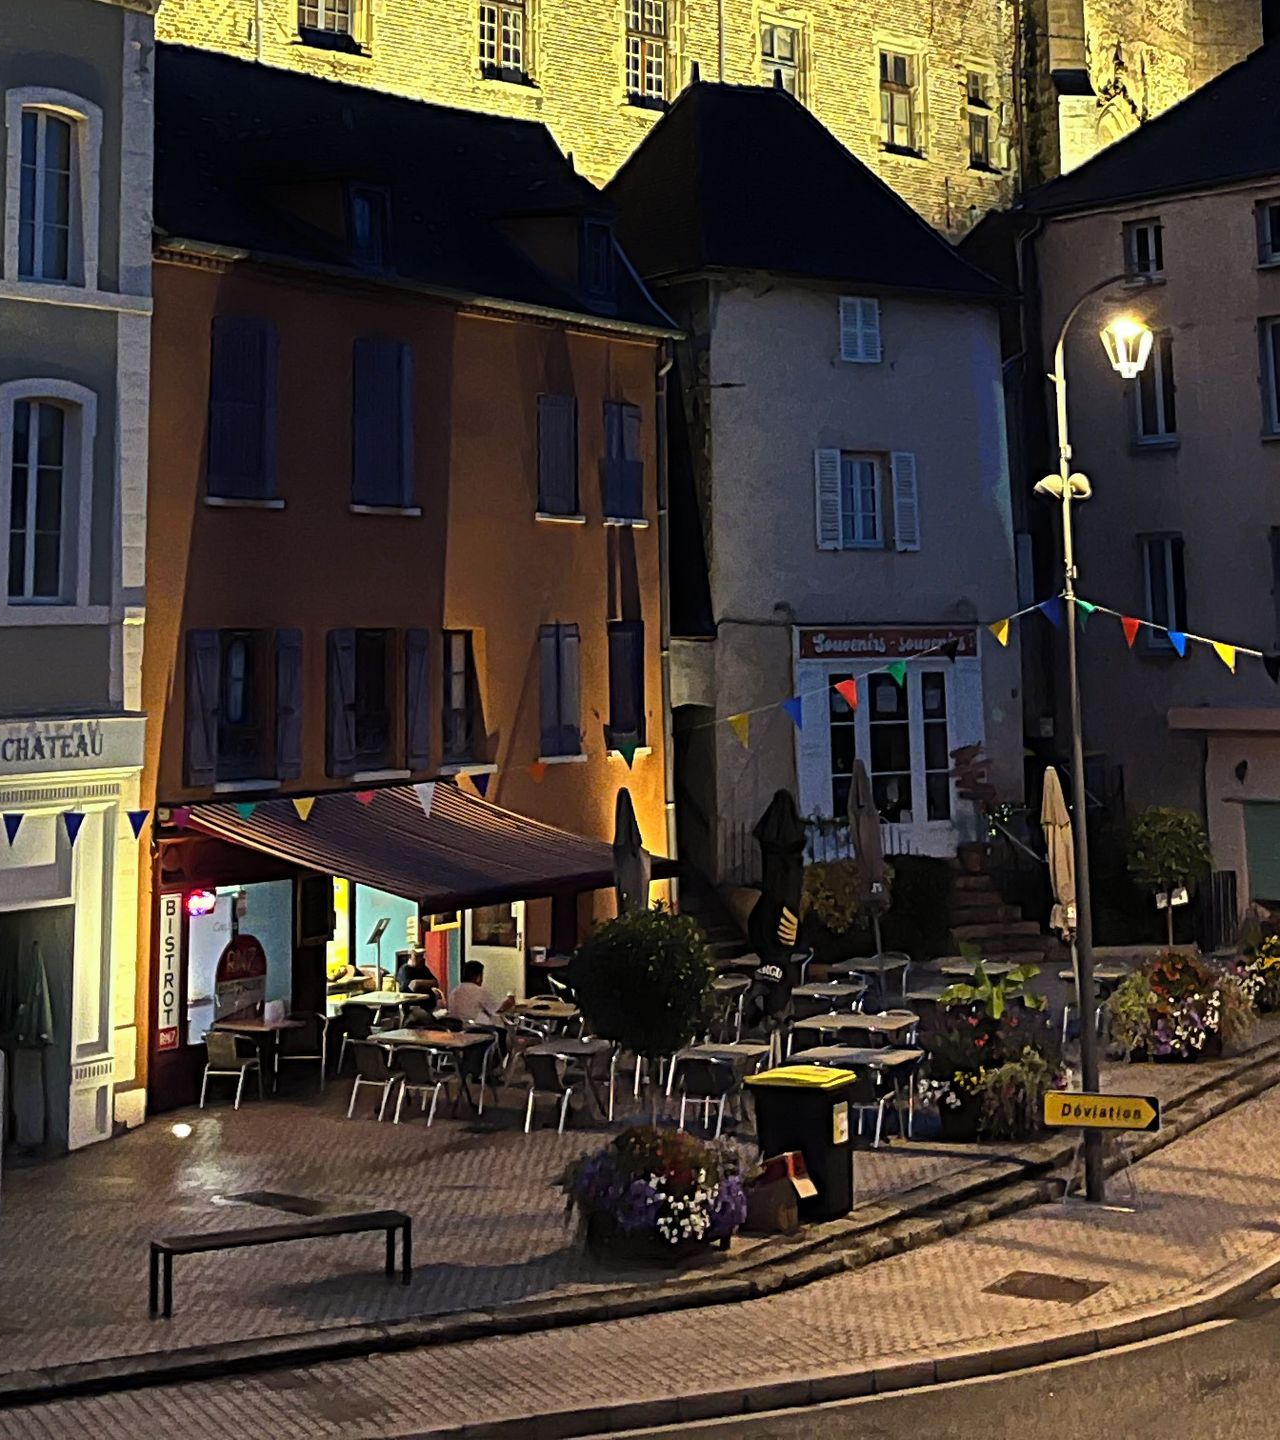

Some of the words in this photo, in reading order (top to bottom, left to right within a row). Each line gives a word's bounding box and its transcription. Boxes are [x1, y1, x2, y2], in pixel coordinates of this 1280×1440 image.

[812, 632, 886, 653] Souvenirs
[163, 899, 176, 1026] BISTROT
[1061, 1103, 1142, 1120] Déviation
